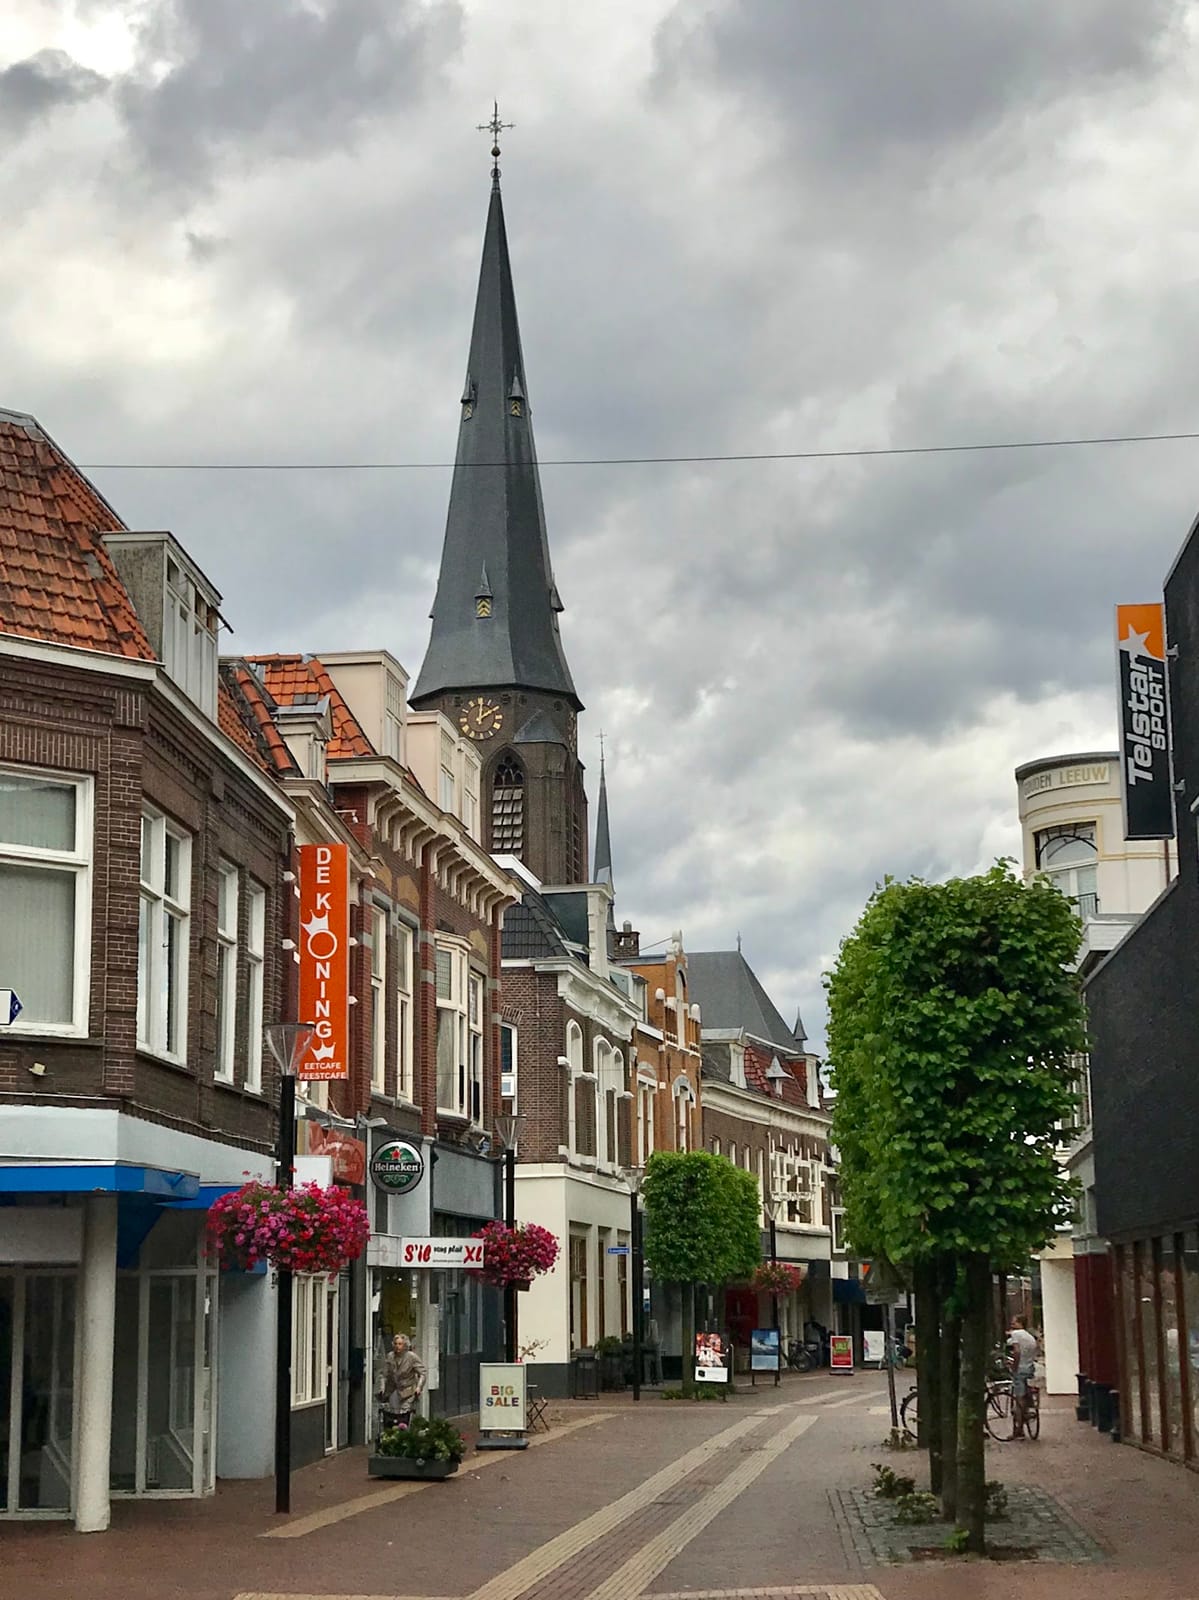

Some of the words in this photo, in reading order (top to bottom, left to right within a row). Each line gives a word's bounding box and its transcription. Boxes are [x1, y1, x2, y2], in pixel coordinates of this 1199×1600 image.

[1149, 666, 1166, 750] SPORT
[1126, 653, 1153, 785] Telstar
[1060, 766, 1106, 784] LEEUW
[316, 847, 332, 884] DE
[307, 892, 338, 1039] KONING
[304, 1062, 341, 1070] EETCAFE
[299, 1072, 346, 1080] FEESTCAFE
[374, 1162, 418, 1172] Heineken
[485, 1396, 520, 1408] SALE
